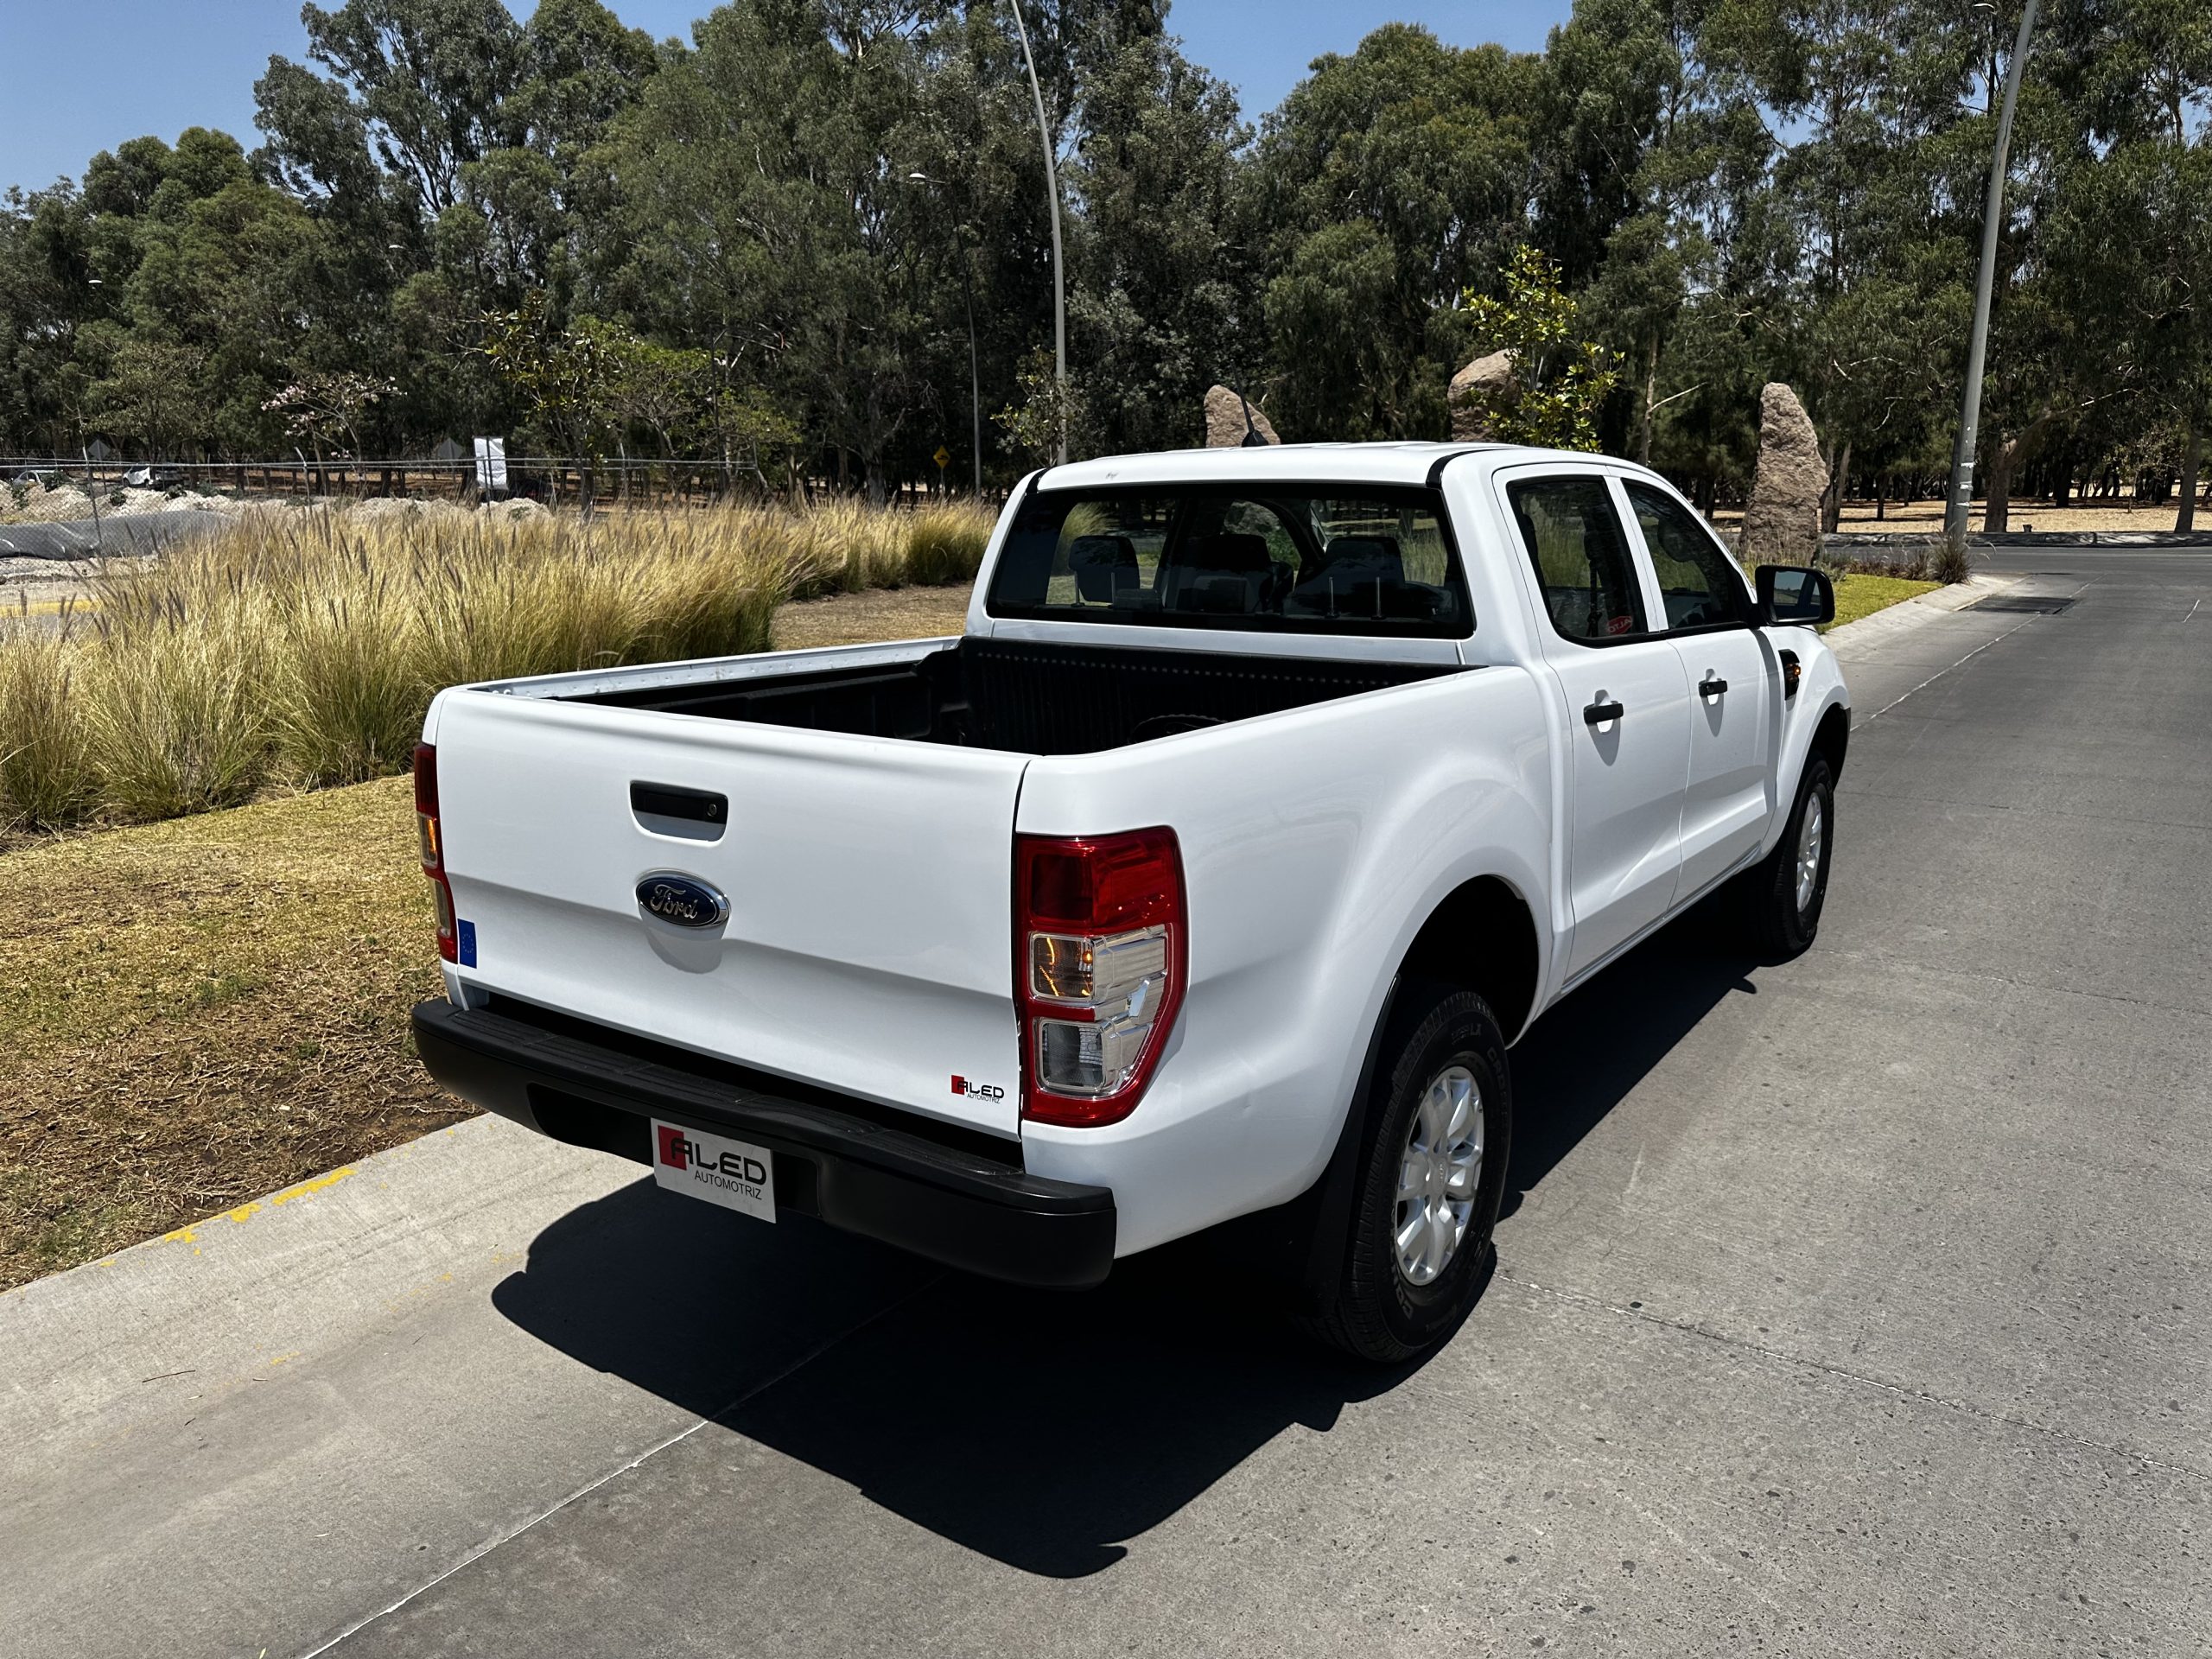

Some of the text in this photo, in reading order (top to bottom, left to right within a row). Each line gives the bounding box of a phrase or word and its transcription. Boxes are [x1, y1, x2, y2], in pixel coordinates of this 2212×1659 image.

[650, 884, 698, 919] Ford
[957, 1081, 1004, 1098] ALED
[967, 1093, 1001, 1104] AUTOMOTRIZ
[671, 1138, 766, 1185] ALED
[694, 1170, 763, 1200] AUTOMOTRIZ
